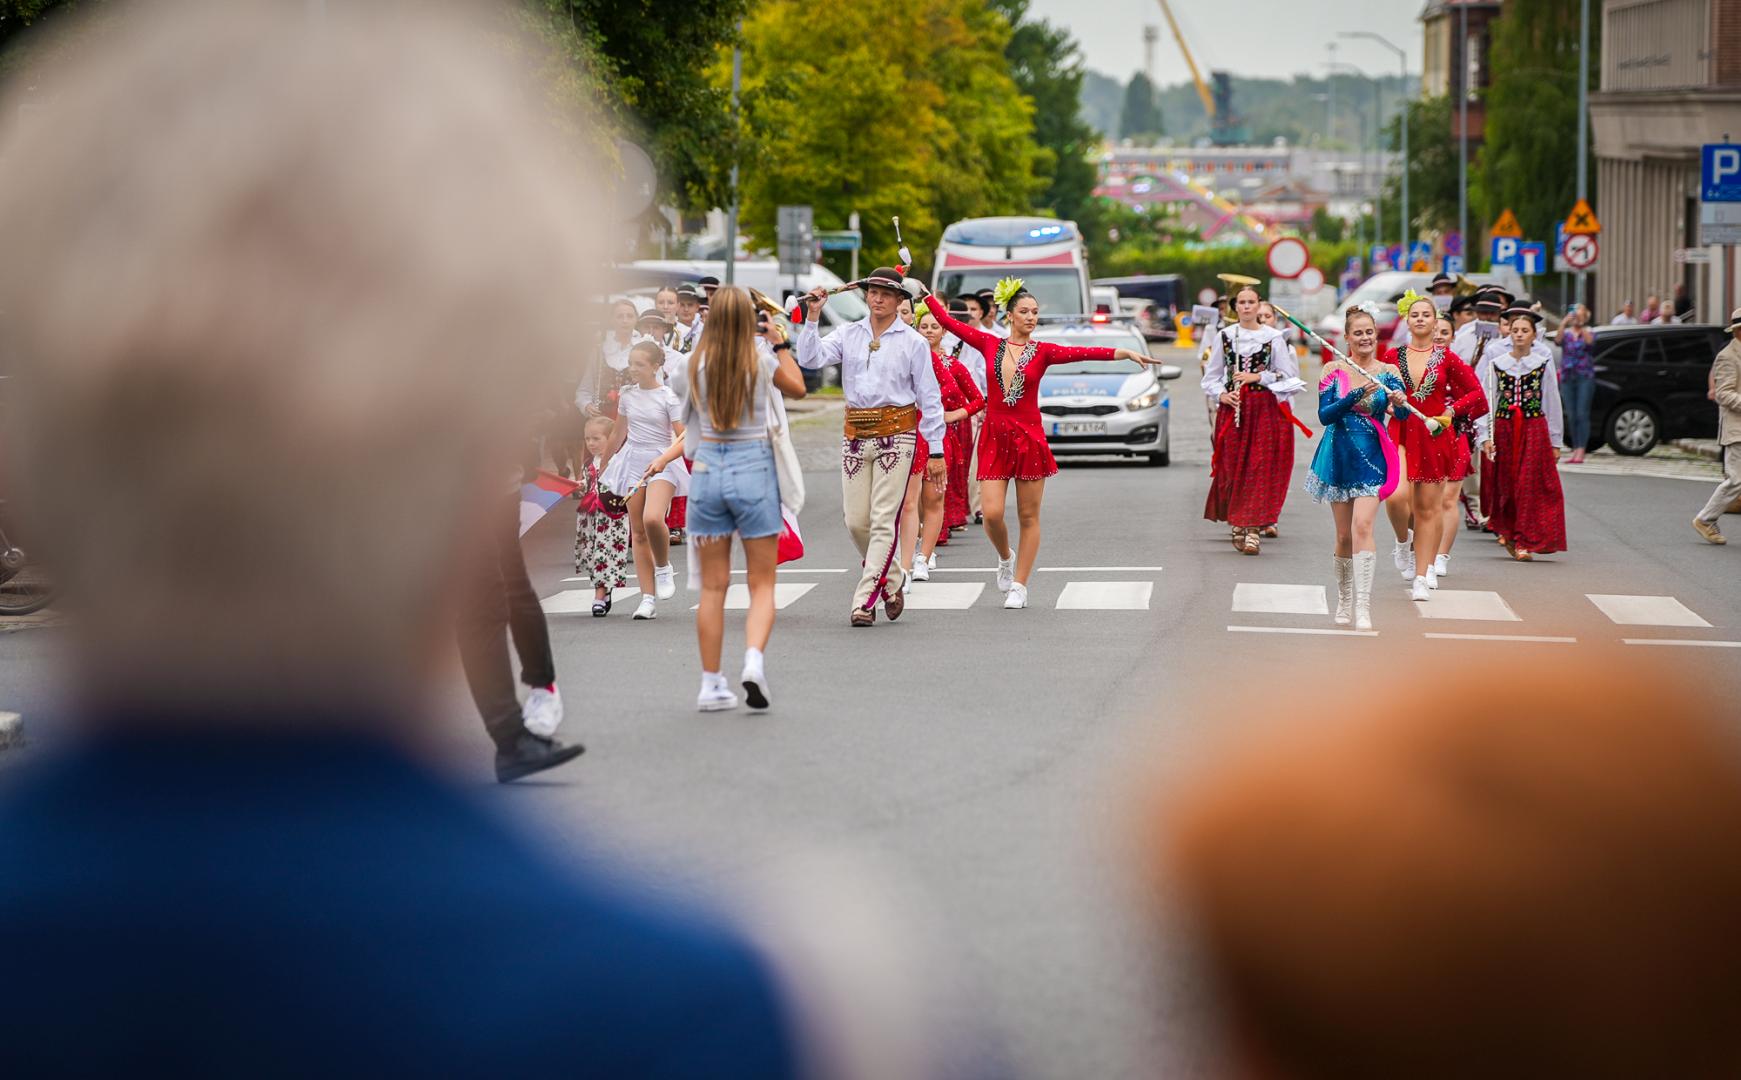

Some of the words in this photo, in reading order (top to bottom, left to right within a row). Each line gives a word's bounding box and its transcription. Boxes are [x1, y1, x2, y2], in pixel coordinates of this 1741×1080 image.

[1712, 149, 1740, 185] P
[1497, 239, 1517, 263] P
[1052, 387, 1107, 396] POLICJA
